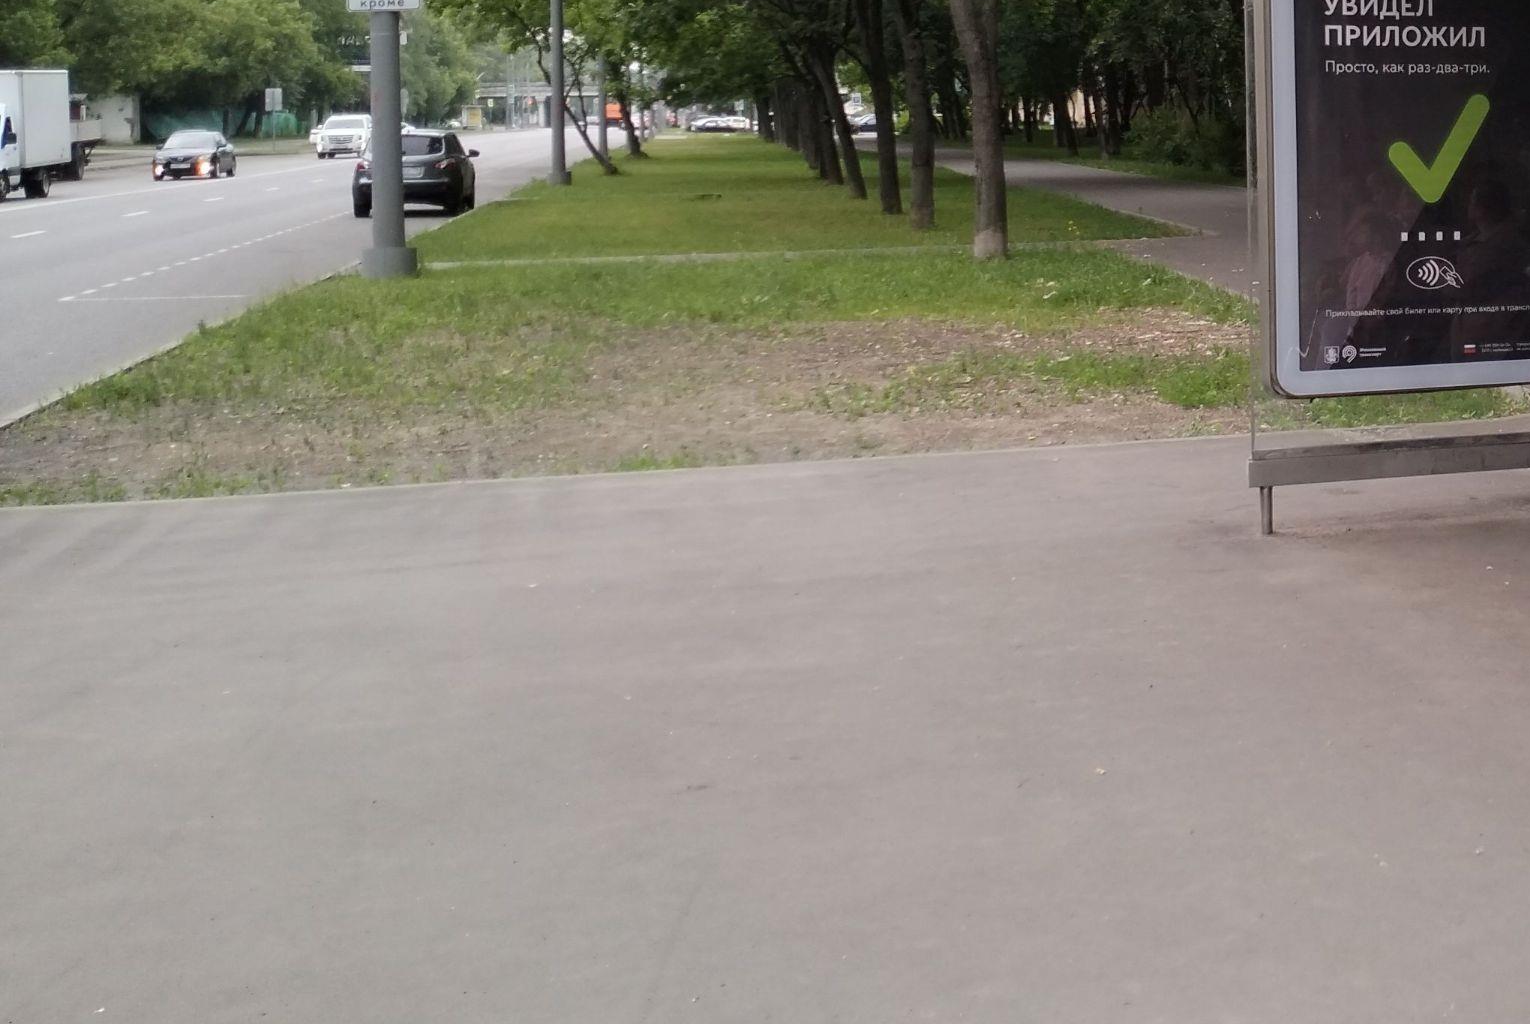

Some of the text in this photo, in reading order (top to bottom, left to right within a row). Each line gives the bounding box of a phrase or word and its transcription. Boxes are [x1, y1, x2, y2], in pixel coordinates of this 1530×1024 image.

[1324, 24, 1487, 47] ПРИЛОЖИЛ
[1325, 60, 1490, 75] Просто, как раз-два-три.
